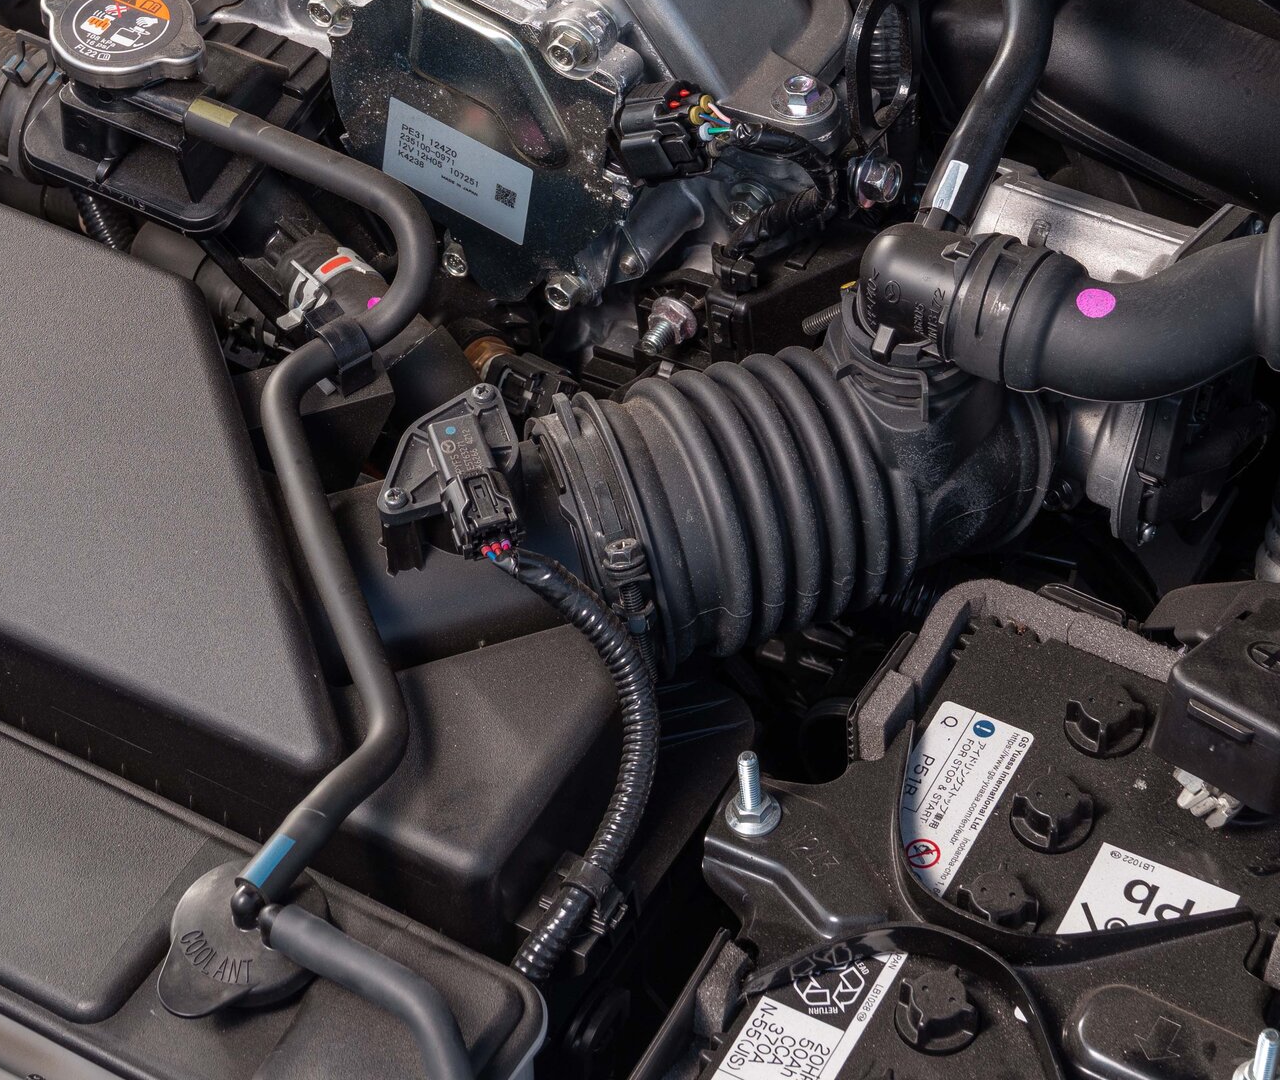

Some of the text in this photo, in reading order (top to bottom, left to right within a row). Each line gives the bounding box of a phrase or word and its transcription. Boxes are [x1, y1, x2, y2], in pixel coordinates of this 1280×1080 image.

[74, 44, 99, 58] FL22
[85, 39, 112, 50] 16 psi
[100, 37, 117, 48] kPa
[399, 132, 456, 167] 235100-0971
[401, 123, 458, 159] PE31 124Z0
[397, 149, 425, 169] K4238
[398, 140, 415, 154] 12V
[449, 167, 480, 188] 107251
[440, 173, 456, 185] MADE
[462, 184, 480, 197] JAPAN
[940, 716, 959, 728] Q
[957, 738, 975, 758] FOR
[1018, 736, 1030, 749] GS
[945, 758, 963, 784] STOP
[1003, 749, 1024, 771] Yuasa
[904, 753, 936, 796] P51R
[977, 770, 1011, 818] International
[968, 817, 981, 831] Ltd.
[940, 837, 971, 881] Inobanba-cho
[1122, 854, 1156, 873] LB1022
[1123, 879, 1196, 921] Pb
[180, 930, 254, 984] COOLANT
[808, 1006, 839, 1015] RETURN
[864, 983, 885, 1013] LB1028
[726, 1001, 778, 1071] N-55(JIS)
[748, 1023, 784, 1065] 370A
[767, 1035, 797, 1065] CCA
[780, 1037, 816, 1078] 50Ah
